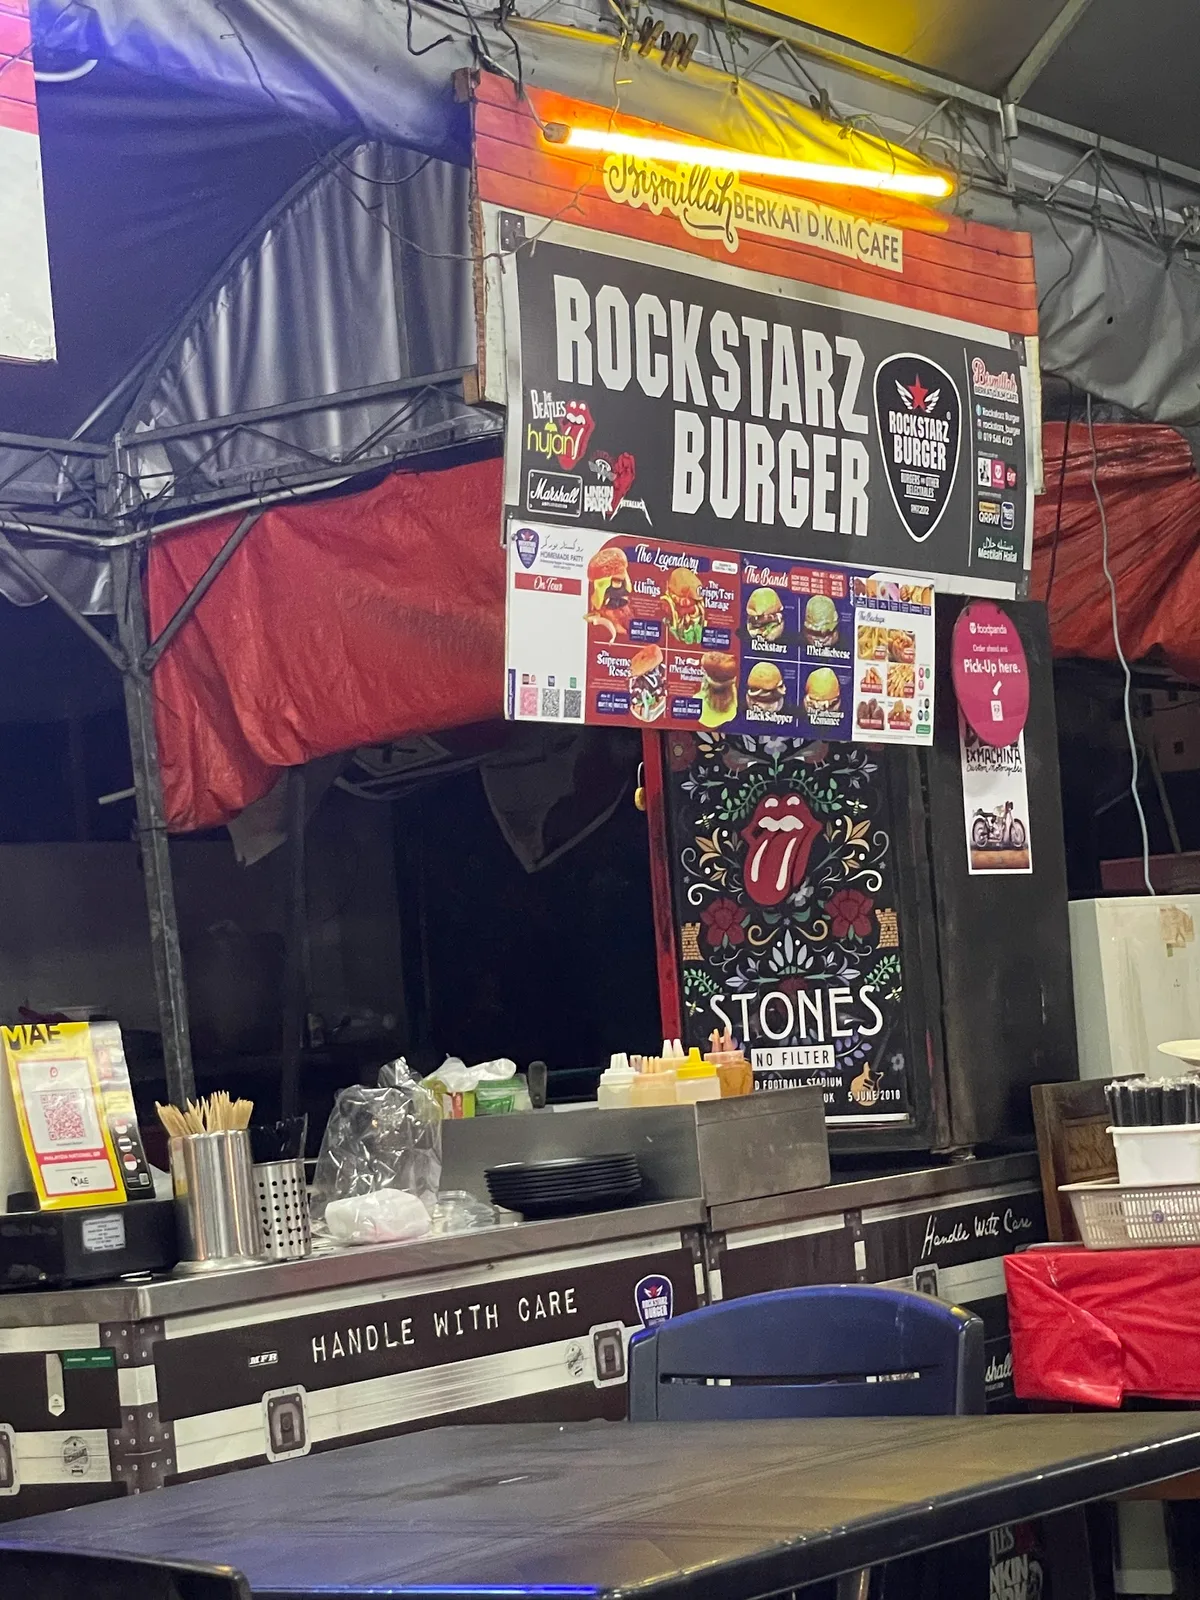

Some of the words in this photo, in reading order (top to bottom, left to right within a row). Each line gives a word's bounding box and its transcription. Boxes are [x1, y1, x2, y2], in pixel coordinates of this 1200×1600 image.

[609, 155, 734, 243] Bismillah
[734, 191, 800, 233] BERKAT
[807, 209, 853, 250] D.K.M
[857, 227, 899, 263] CAFE
[553, 275, 869, 435] ROCKSTARZ
[531, 389, 566, 422] BEATLES
[889, 410, 950, 443] ROCKSTARZ
[527, 423, 574, 459] hujan
[894, 434, 946, 471] BURGER
[672, 409, 870, 537] BURGER
[530, 478, 580, 504] Marshall
[584, 485, 613, 498] LINKIN
[584, 496, 613, 520] PARK
[635, 544, 652, 563] The
[653, 547, 699, 574] Legendary
[708, 580, 719, 589] The
[744, 564, 760, 583] The
[761, 567, 788, 587] Bands
[634, 580, 661, 597] Wings
[696, 586, 719, 600] Crispy
[719, 588, 735, 600] Tori
[977, 623, 1007, 636] foodpanda
[751, 640, 787, 653] Rockstarz
[806, 645, 850, 659] Metallicheese
[596, 653, 631, 667] Supreme
[608, 664, 632, 677] Roses
[964, 658, 997, 677] Pick-Up
[998, 658, 1021, 673] here.
[709, 985, 883, 1042] STONES
[756, 1052, 773, 1067] NO
[782, 1050, 829, 1065] FILTER
[806, 1077, 843, 1088] STADIUM
[823, 1092, 835, 1103] UK
[848, 1091, 853, 1102] 5
[856, 1091, 877, 1101] JUNE
[880, 1089, 901, 1100] 2018
[920, 1215, 970, 1259] Handle
[974, 1212, 1000, 1238] With
[1003, 1208, 1032, 1233] Care
[644, 1305, 668, 1320] BURGER
[311, 1317, 415, 1363] HANDLE
[434, 1303, 500, 1338] WITH
[518, 1288, 578, 1322] CARE
[985, 1352, 1013, 1383] shall
